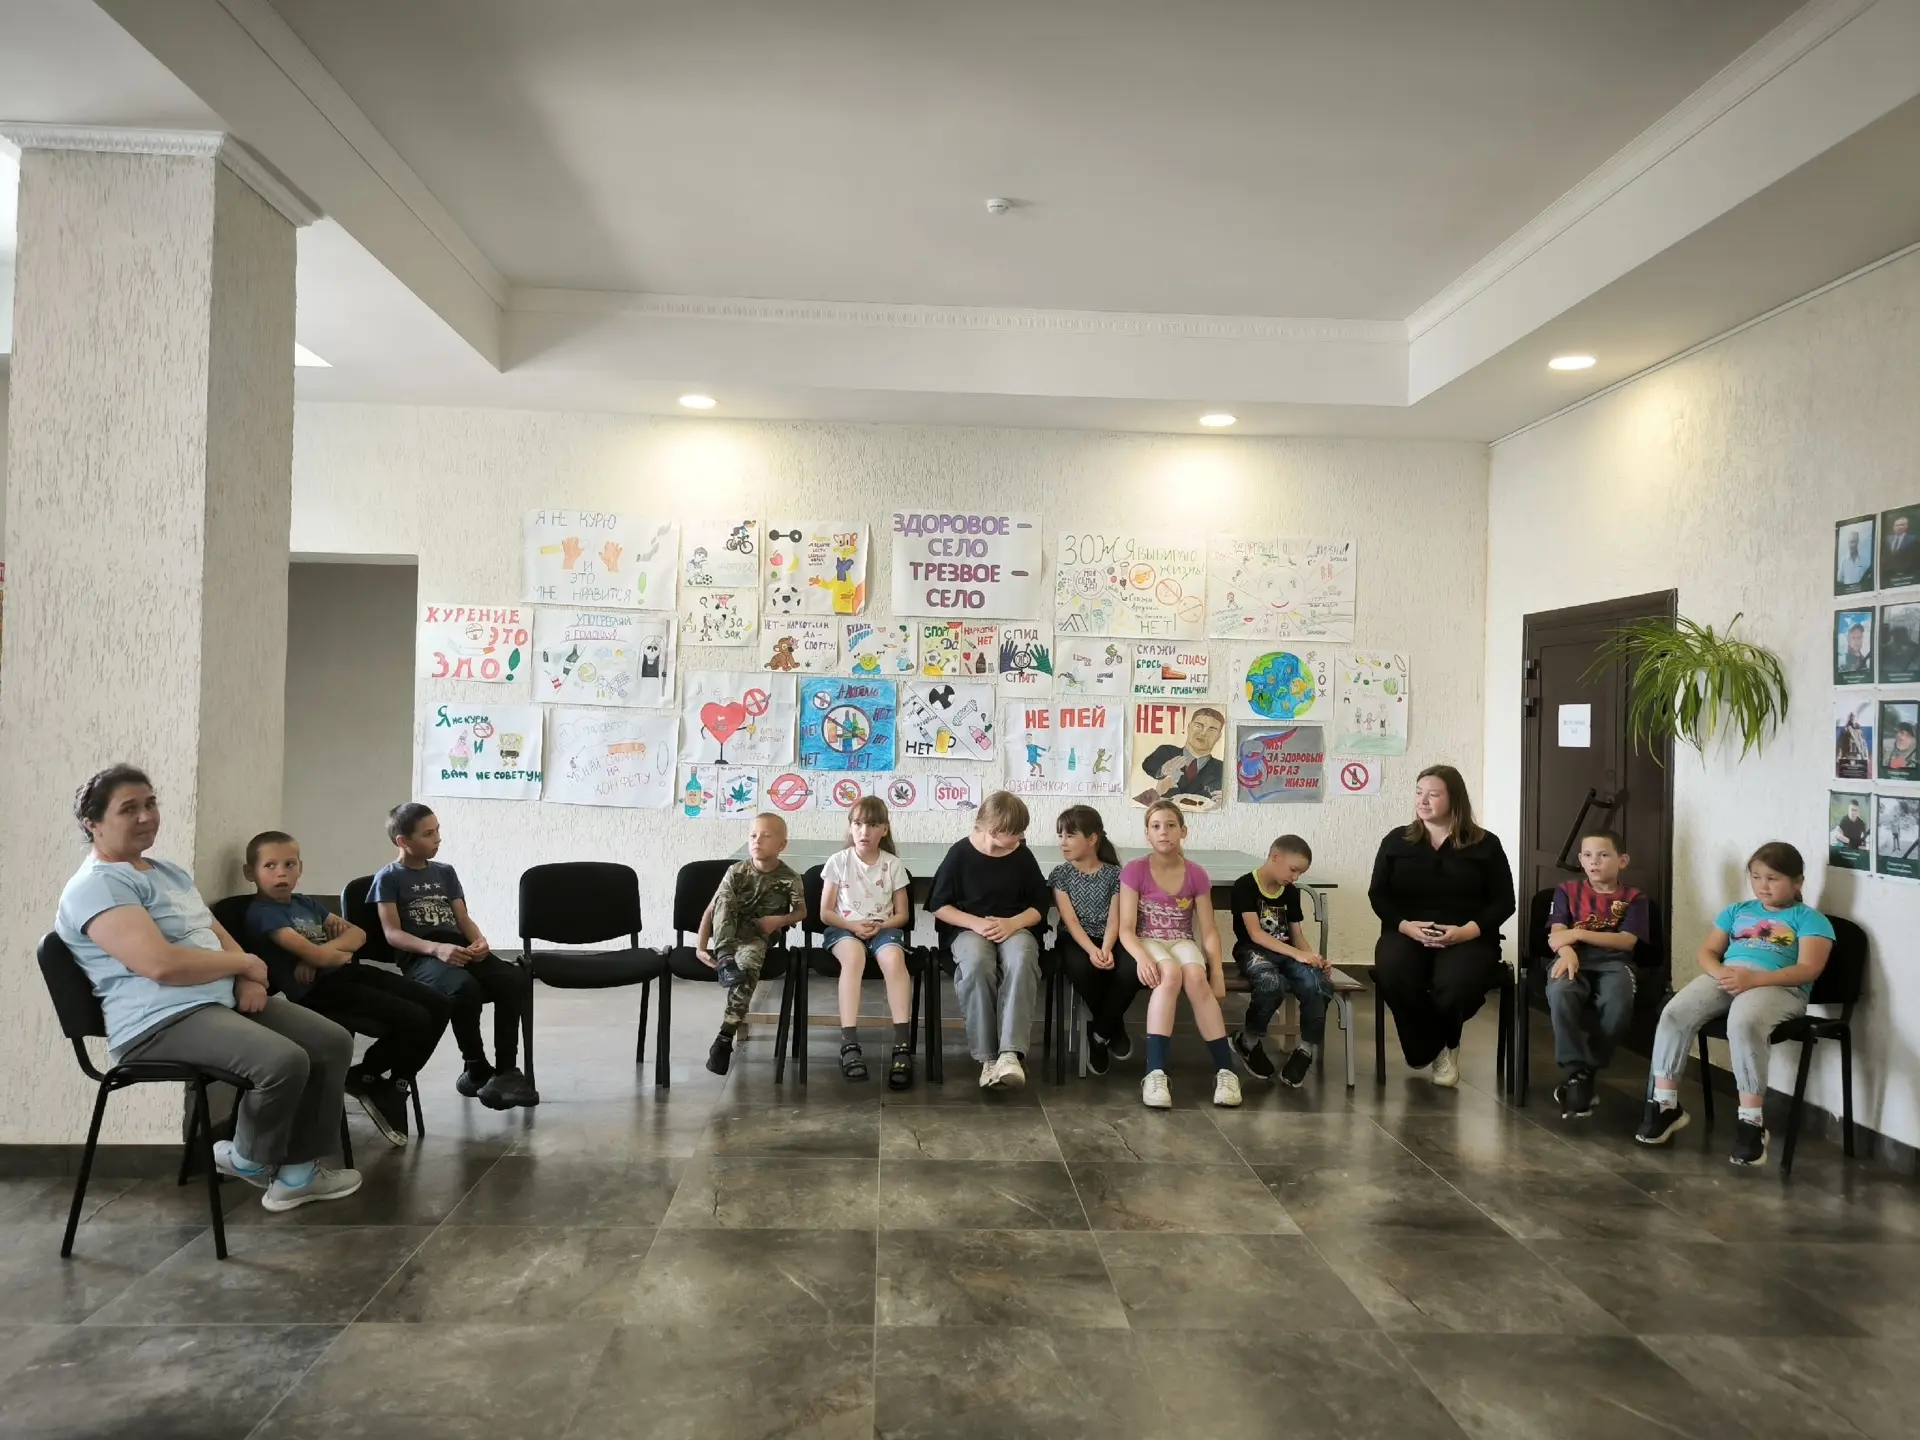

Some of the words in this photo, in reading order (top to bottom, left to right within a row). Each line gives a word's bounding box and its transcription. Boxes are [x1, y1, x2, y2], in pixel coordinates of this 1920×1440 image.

[536, 510, 546, 525] Я
[552, 511, 568, 527] НЕ
[580, 512, 618, 530] КУРЮ
[893, 513, 1010, 538] ЗДОРОВОЕ
[928, 538, 989, 558] СЕЛО
[1138, 547, 1198, 561] ВЫБИРАЮ
[584, 560, 593, 572] И
[909, 561, 1001, 583] ТРЕЗВОЕ
[570, 572, 596, 584] ЭТО
[534, 585, 558, 600] МНЕ
[926, 588, 986, 609] СЕЛО
[425, 606, 520, 624] КУРЕНИЕ
[764, 619, 780, 630] НЕТ
[847, 623, 872, 637] БУДЬТЕ
[488, 626, 529, 647] ЭТО
[924, 625, 950, 639] СПОРТ
[1004, 629, 1039, 641] СПИД
[804, 640, 837, 651] СПОРТУ!
[977, 635, 994, 646] НЕТ
[1136, 644, 1176, 656] СКАЖИ
[1136, 660, 1162, 670] БРОСЬ
[1176, 654, 1208, 666] СПИДУ
[1190, 674, 1208, 684] НЕТ
[1135, 684, 1166, 694] ВРЕДНЫЕ
[1170, 685, 1208, 695] ПРИВЫЧКИ
[435, 704, 451, 728] Я
[1025, 709, 1050, 729] НЕ
[1060, 704, 1106, 729] ПЕЙ
[1136, 703, 1187, 734] НЕТ!
[473, 739, 484, 755] И
[905, 740, 934, 755] НЕТ
[800, 752, 821, 768] НЕТ
[846, 752, 873, 769] НЕТ
[1267, 752, 1280, 763] ЗА
[1280, 751, 1324, 763] ЗДОРОВЫЙ
[441, 768, 469, 781] ВАМ
[606, 764, 621, 777] НА
[1267, 765, 1300, 775] ОБРАЗ
[1284, 777, 1320, 788] ЖИЗНИ
[938, 787, 968, 801] STOP
